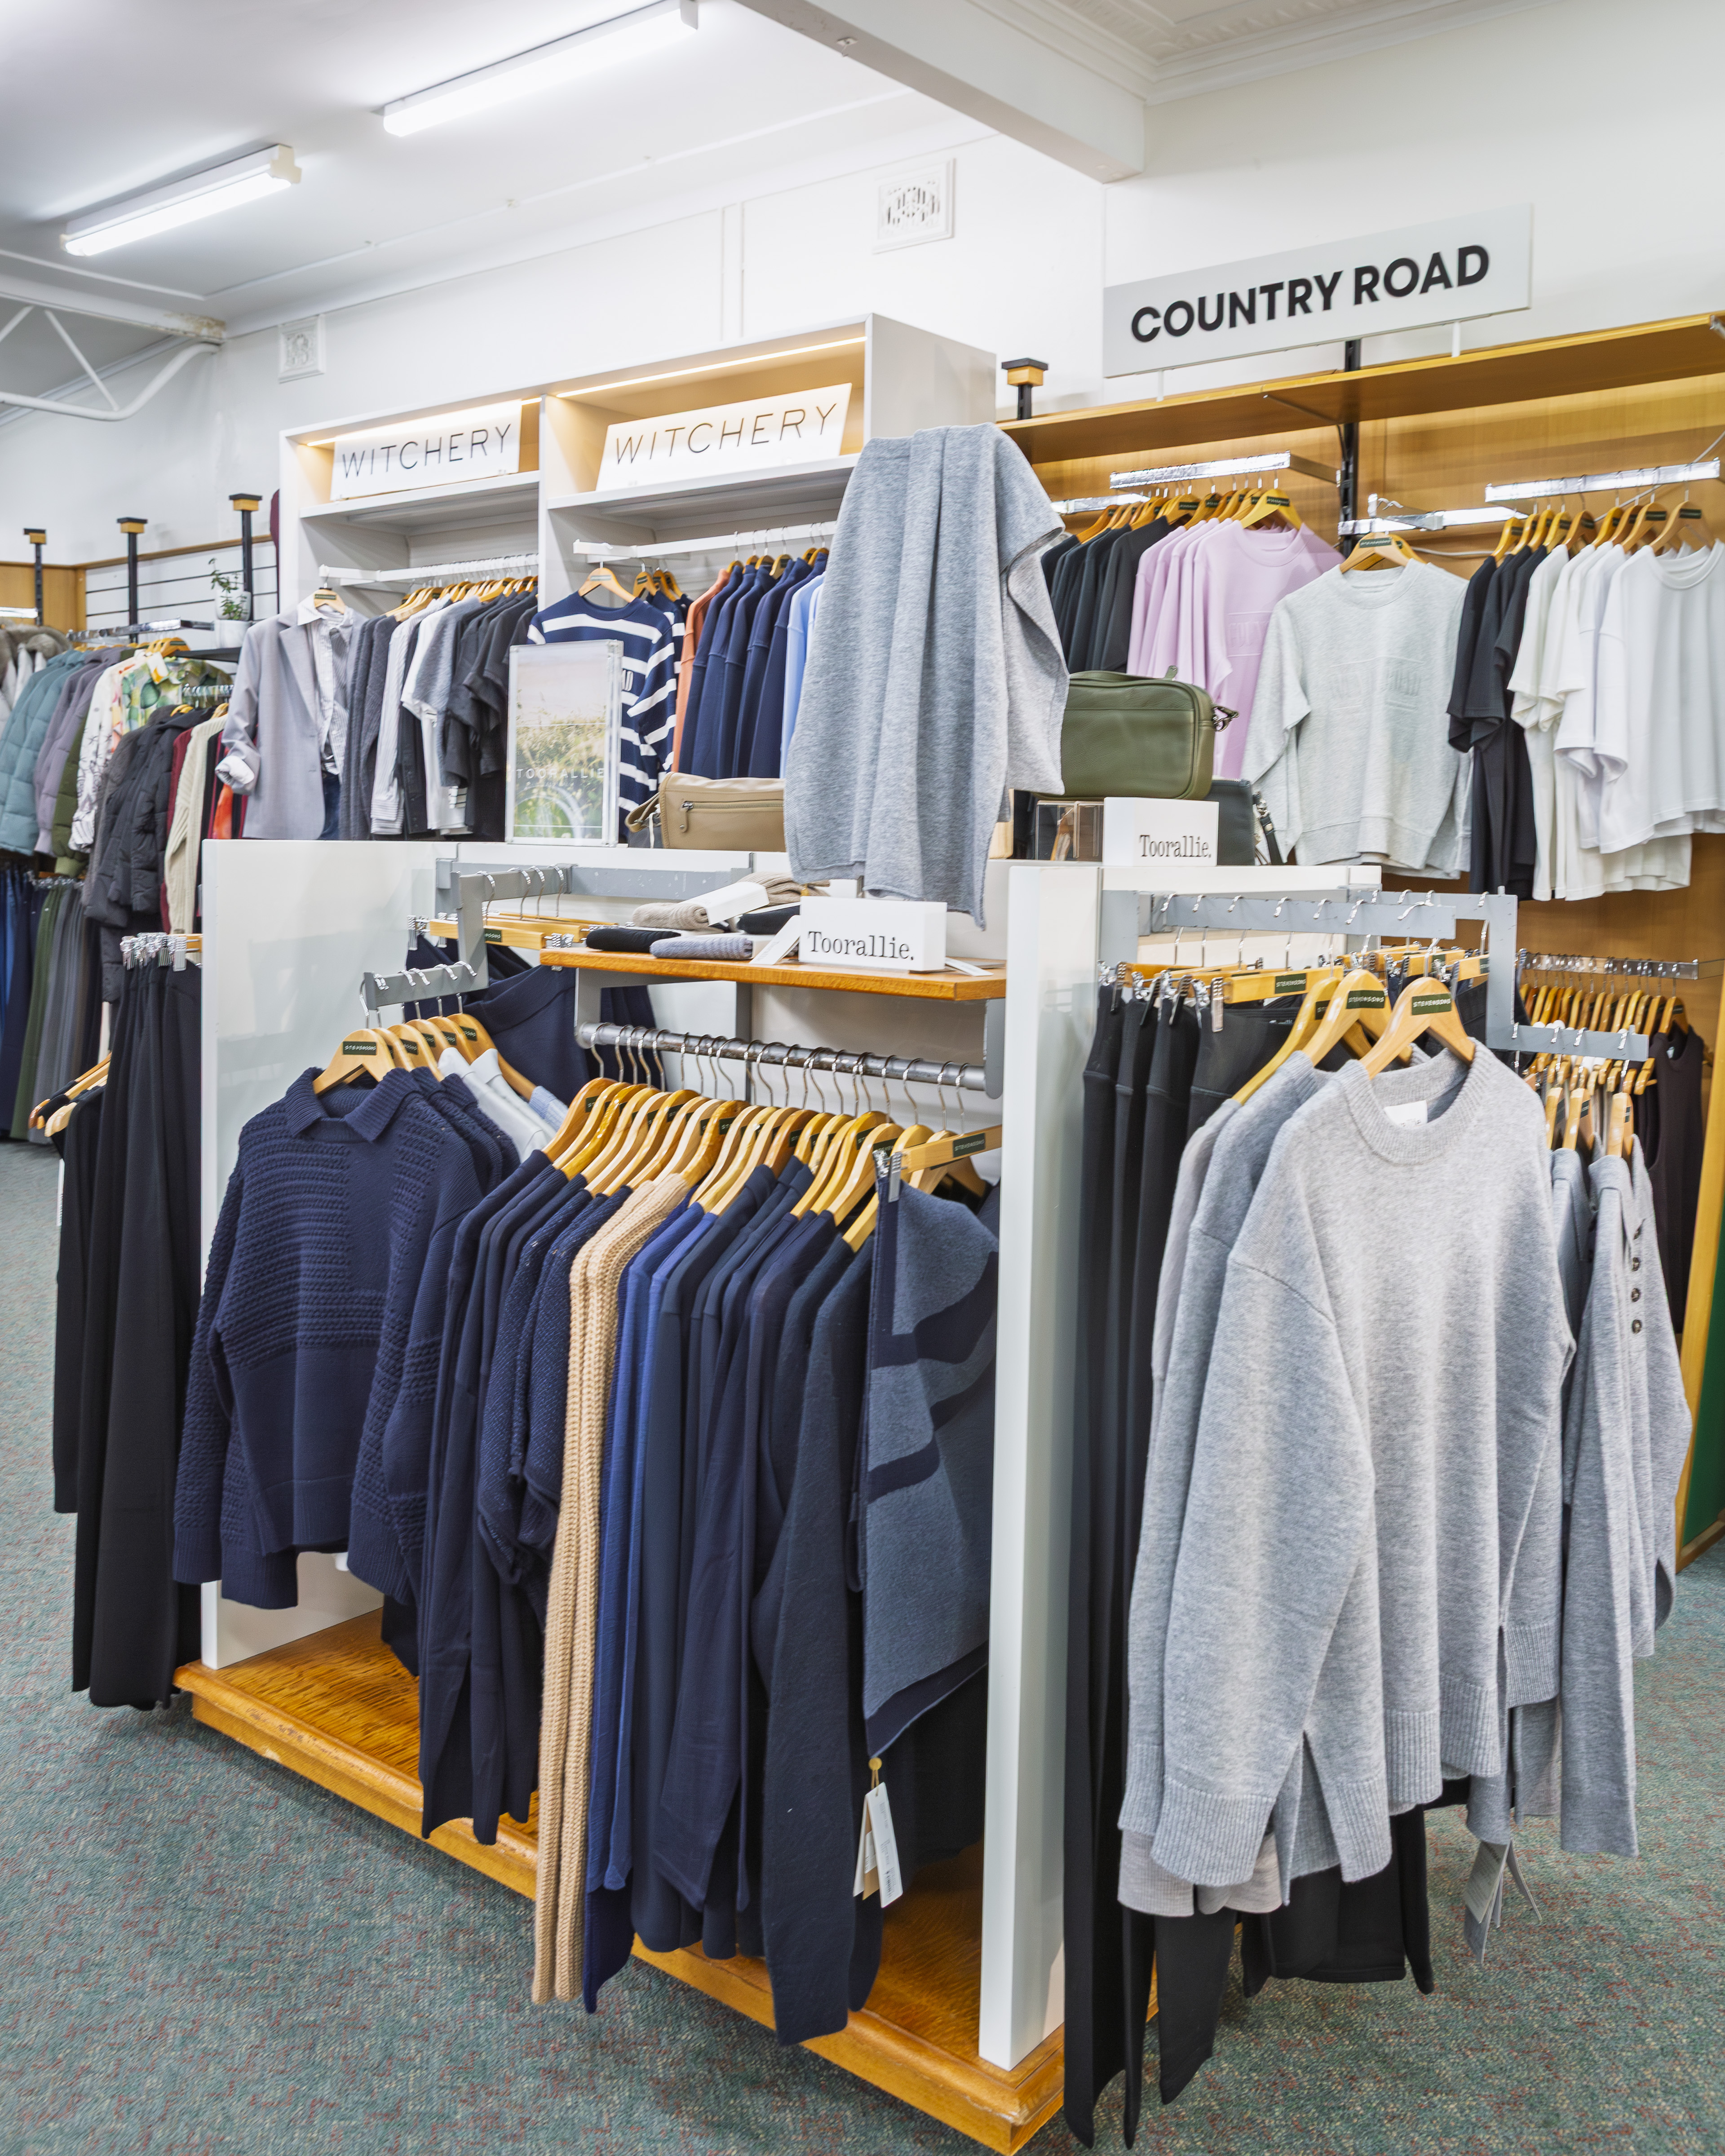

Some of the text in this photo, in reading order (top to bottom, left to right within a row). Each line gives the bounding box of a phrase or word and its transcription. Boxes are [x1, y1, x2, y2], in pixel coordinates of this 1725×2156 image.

[1131, 245, 1490, 342] COUNTRY ROAD
[616, 402, 837, 465] WITCHERY
[342, 424, 511, 479] WITCHERY
[516, 768, 605, 779] TOORALLIE
[1139, 834, 1212, 858] Toorallie.
[808, 931, 915, 961] Toorallie.
[1412, 998, 1451, 1008] STEVENSONS
